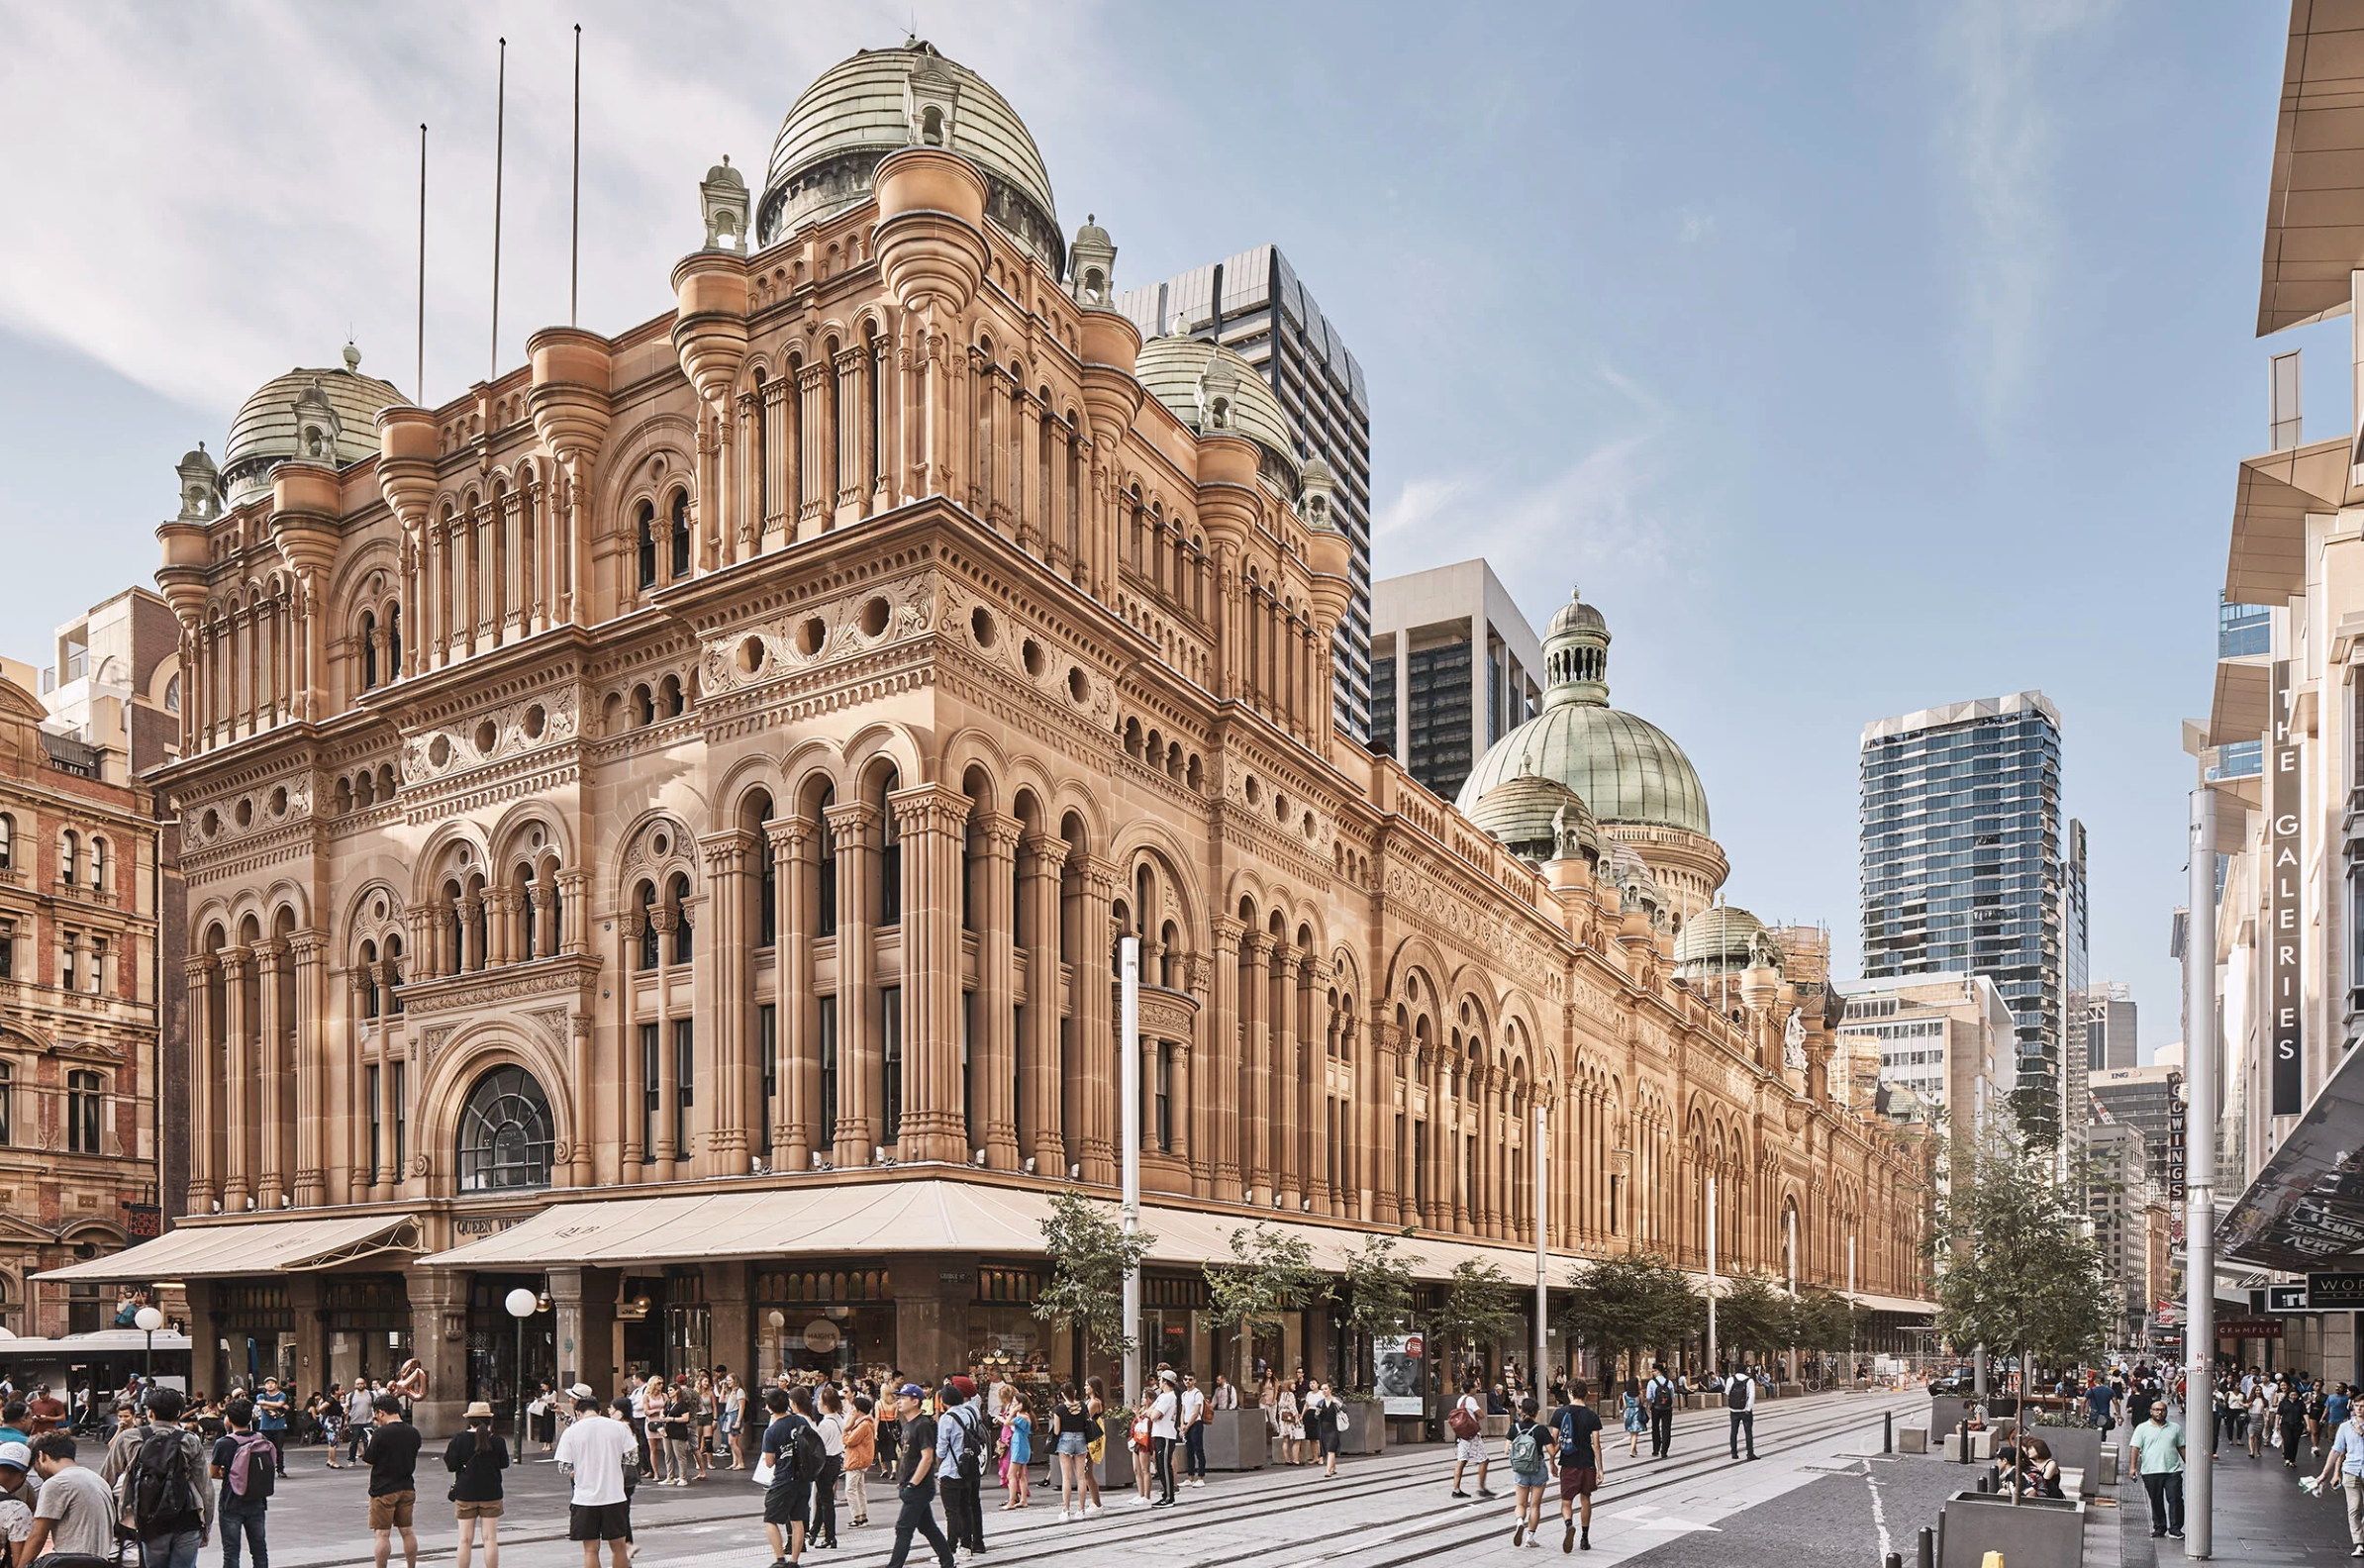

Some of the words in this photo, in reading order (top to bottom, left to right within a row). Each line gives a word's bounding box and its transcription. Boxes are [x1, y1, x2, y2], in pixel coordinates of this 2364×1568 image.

[2277, 688, 2295, 772] THE
[2275, 814, 2299, 1060] GALERIES
[131, 1213, 159, 1222] HONG
[131, 1220, 159, 1228] KONG
[456, 1220, 493, 1235] QUEEN
[131, 1227, 158, 1236] HOUSE
